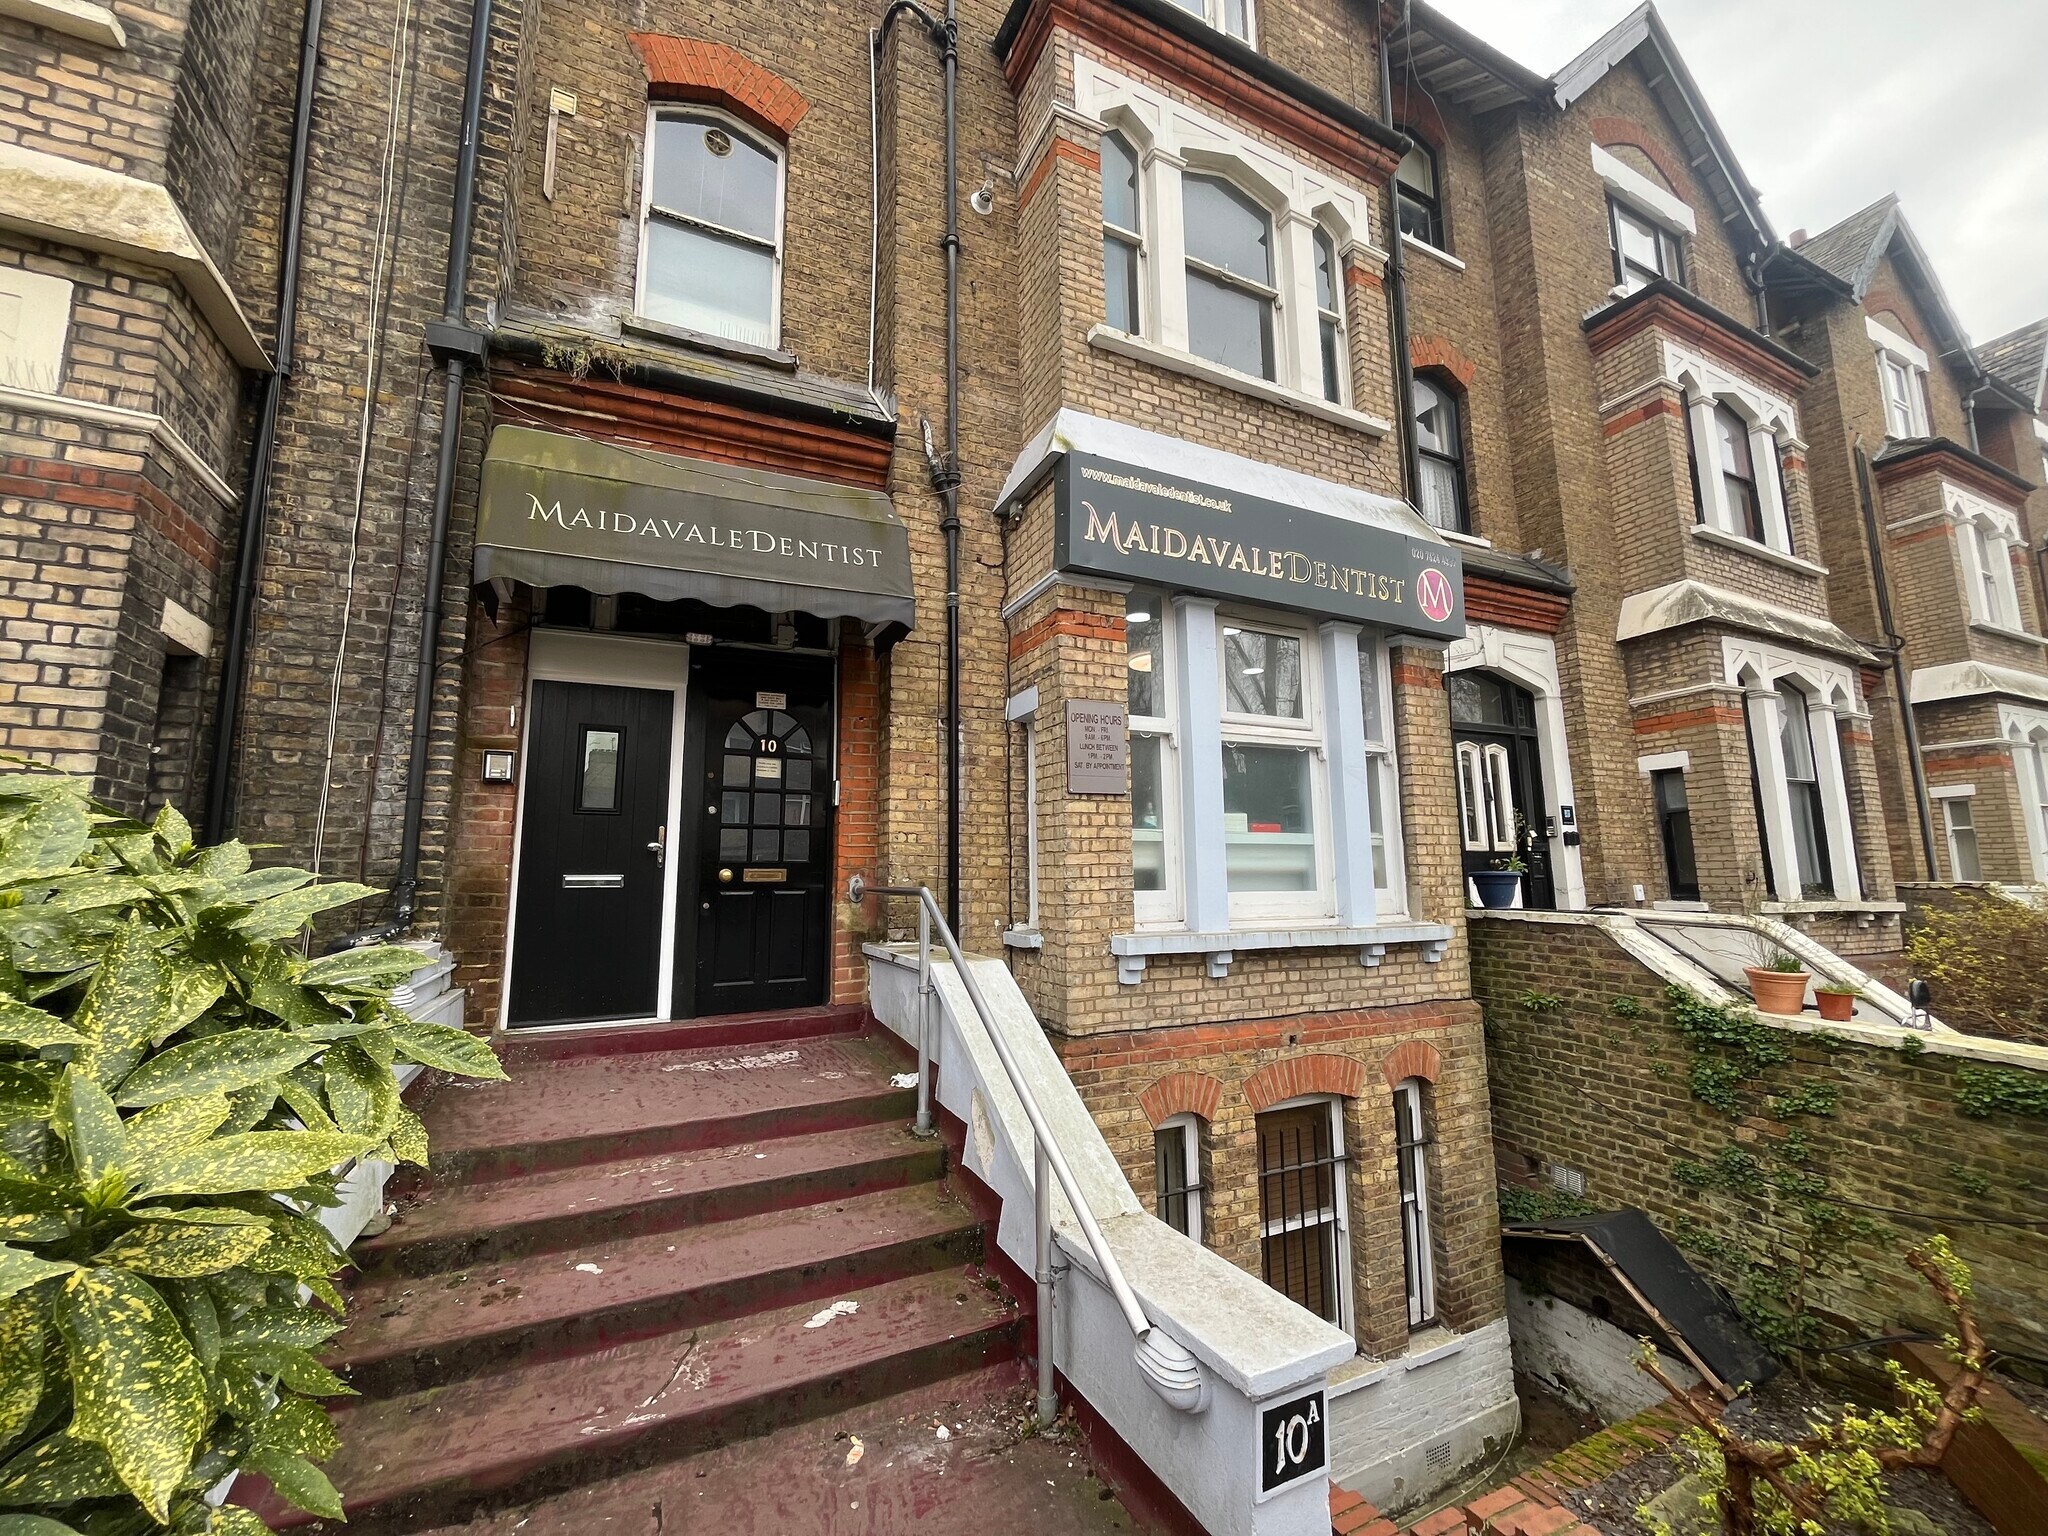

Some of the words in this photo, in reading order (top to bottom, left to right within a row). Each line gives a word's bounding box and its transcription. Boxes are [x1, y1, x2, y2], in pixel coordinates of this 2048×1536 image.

[1081, 466, 1232, 513] www.maidavaledentist.co.uk
[1422, 573, 1450, 615] M
[1071, 713, 1098, 723] OPENING
[1100, 715, 1121, 725] HOURS
[760, 739, 777, 753] 10
